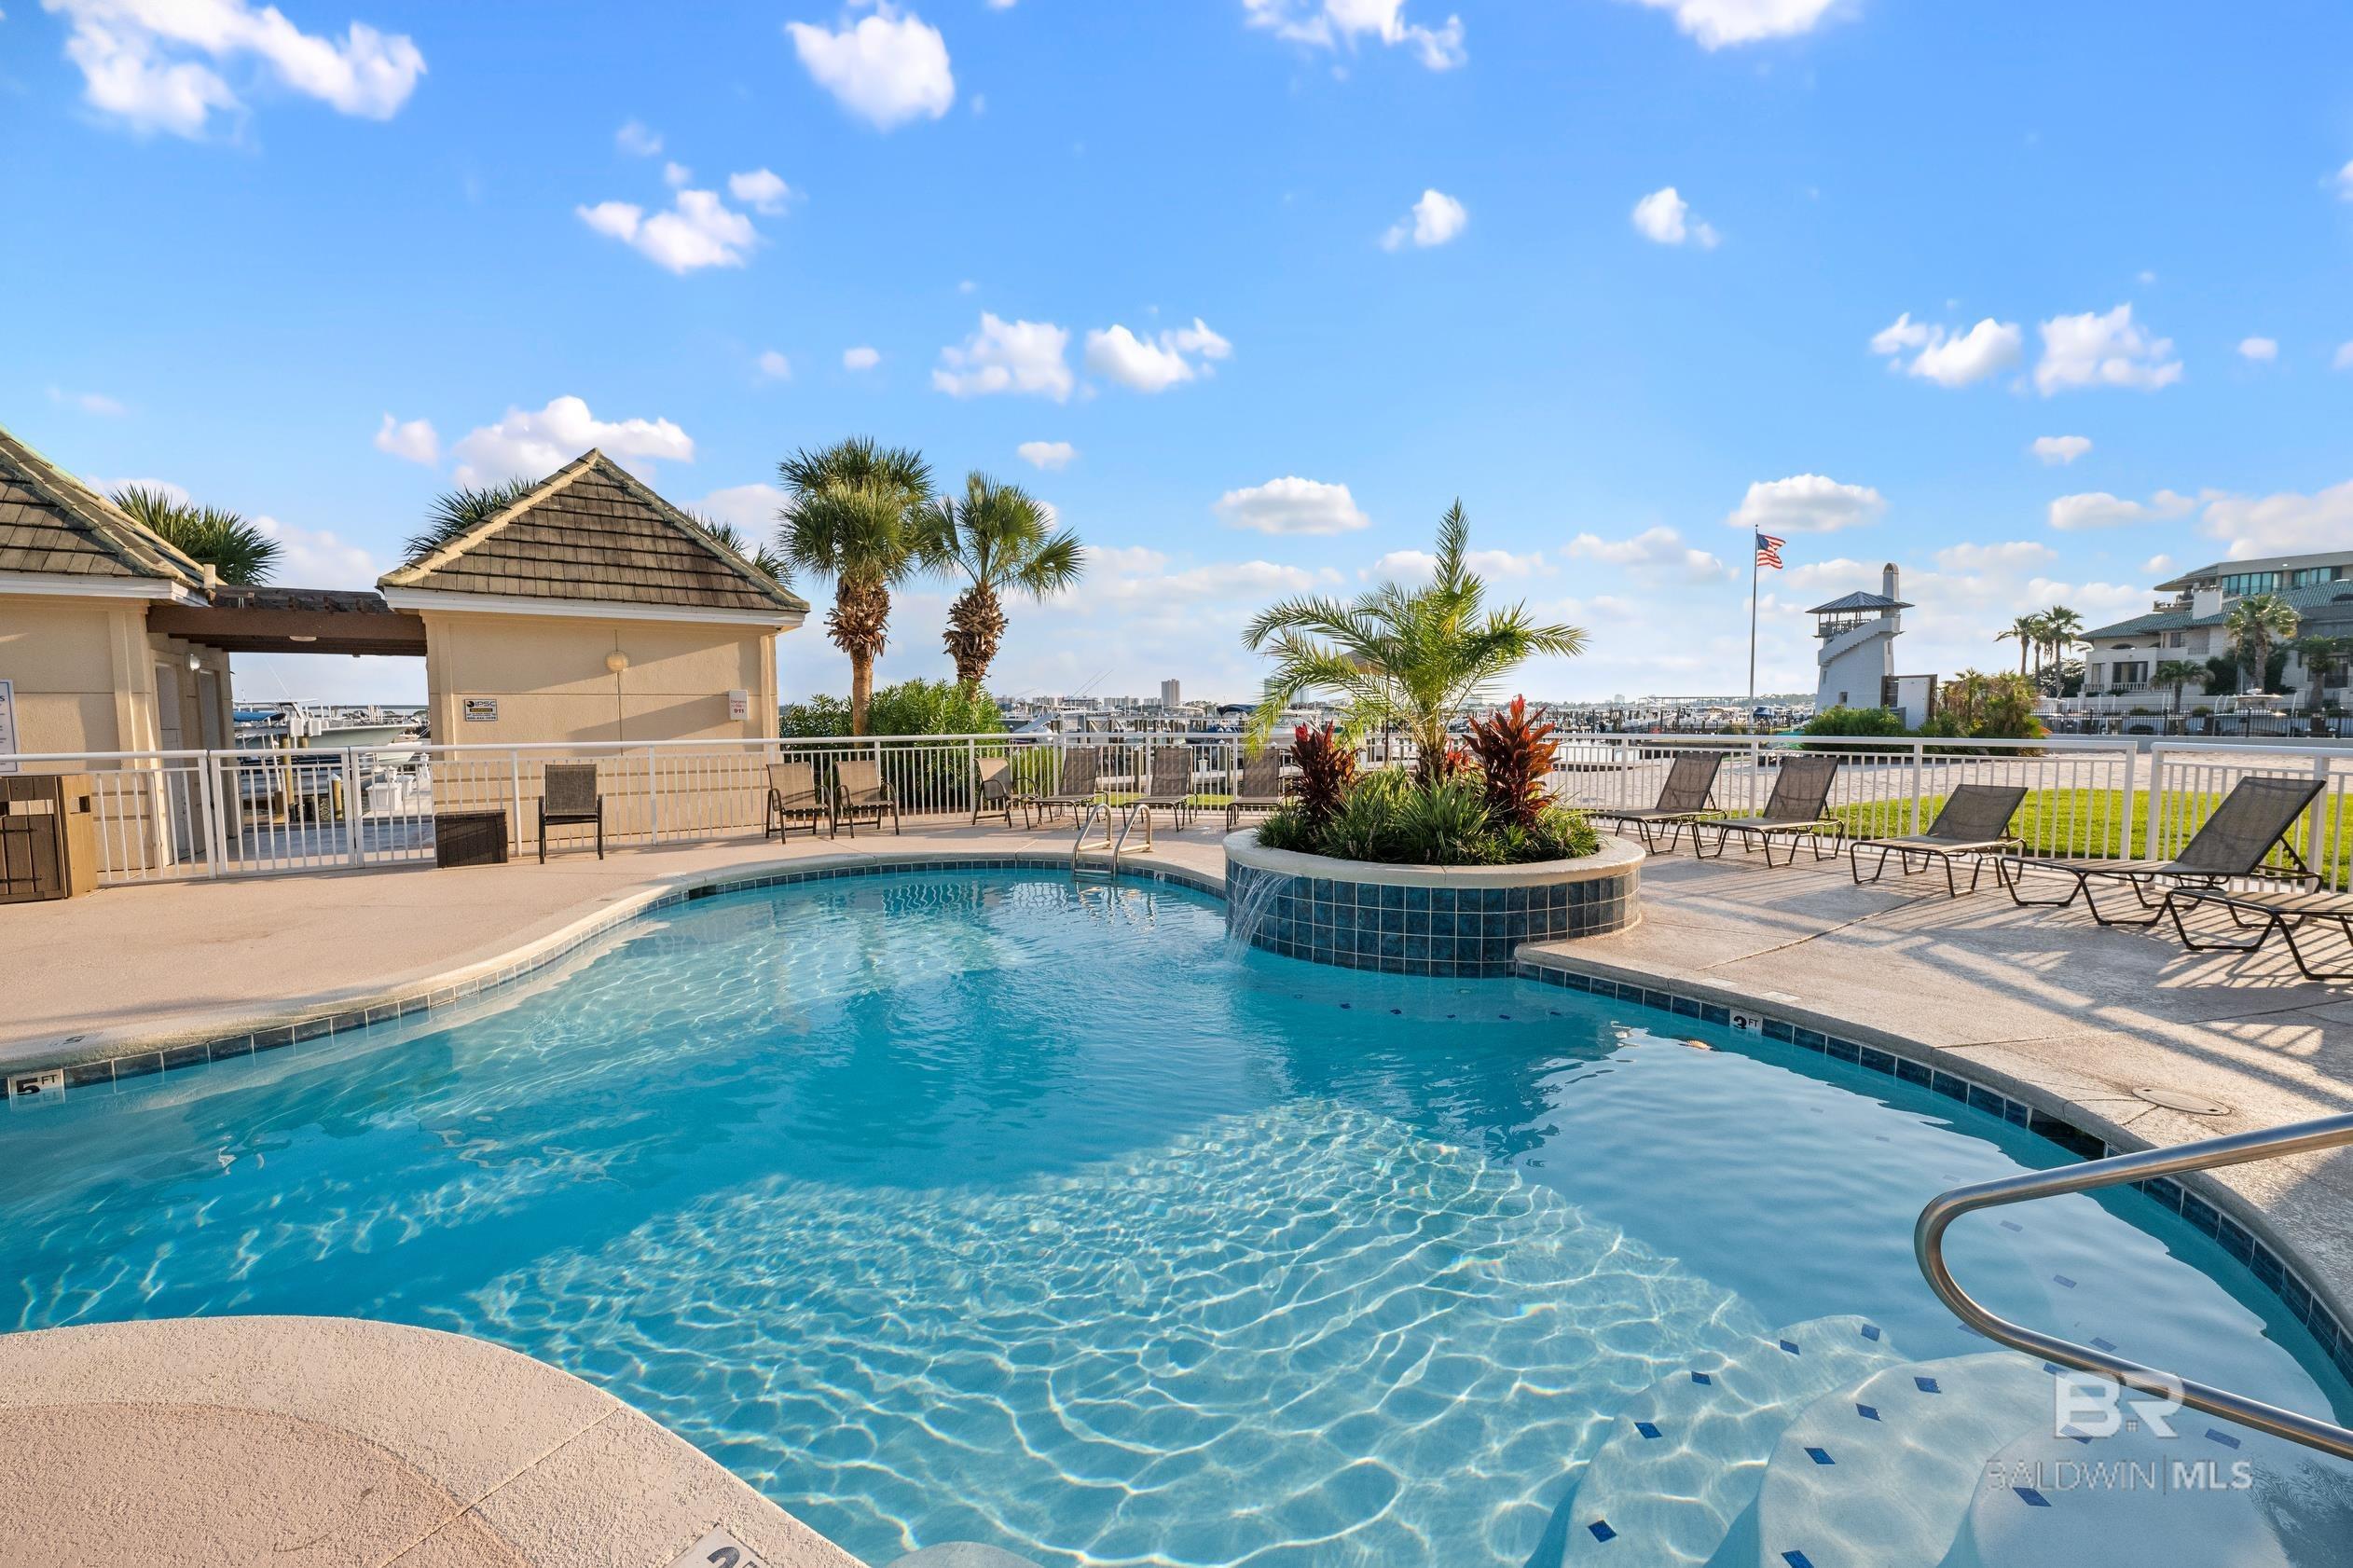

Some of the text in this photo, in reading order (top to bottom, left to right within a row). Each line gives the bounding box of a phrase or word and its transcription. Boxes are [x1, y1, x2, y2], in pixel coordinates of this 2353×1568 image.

[1733, 1015, 1758, 1029] 3 FT
[16, 1074, 58, 1095] 5 FT
